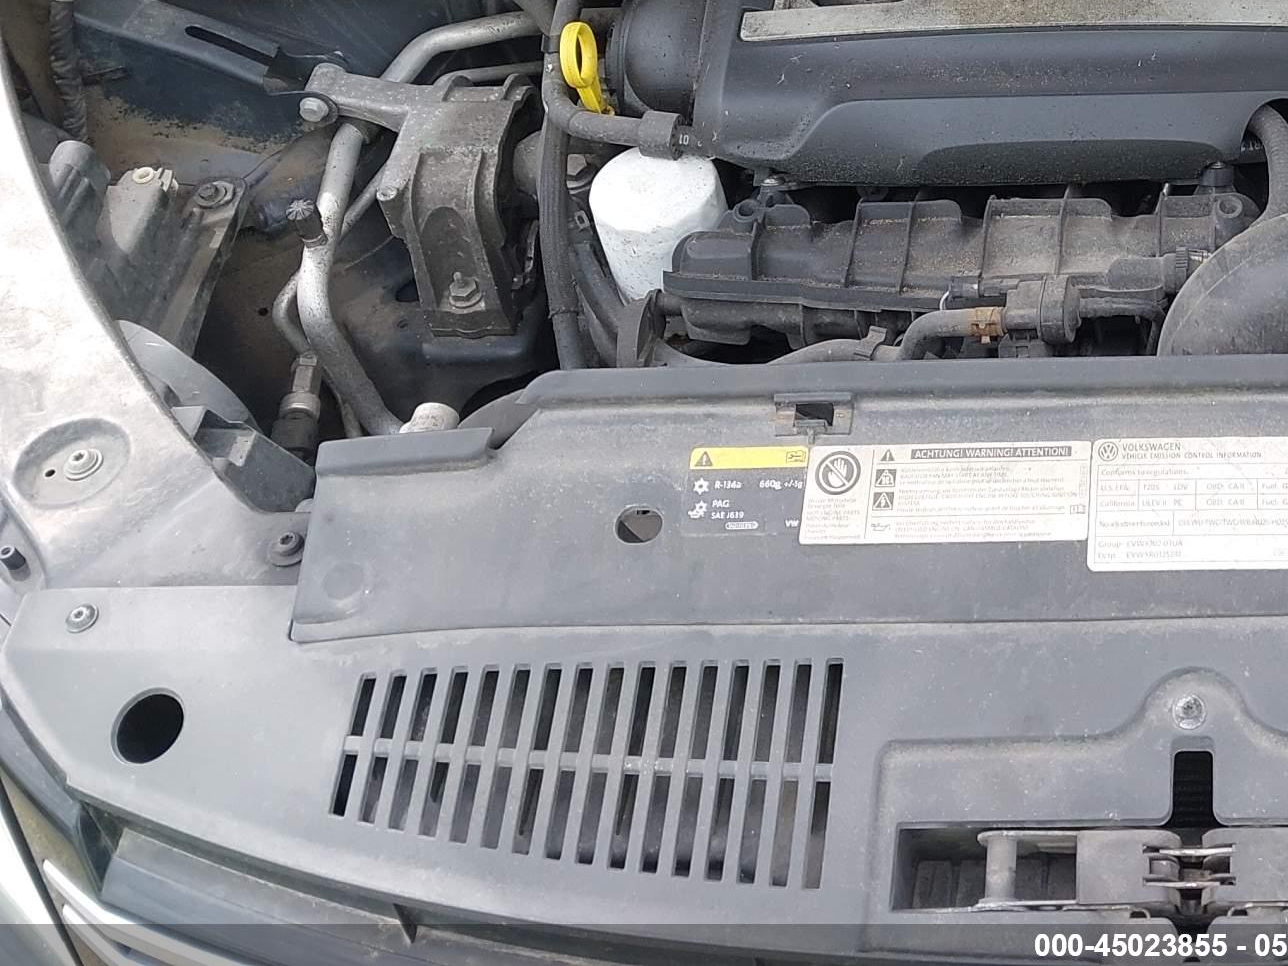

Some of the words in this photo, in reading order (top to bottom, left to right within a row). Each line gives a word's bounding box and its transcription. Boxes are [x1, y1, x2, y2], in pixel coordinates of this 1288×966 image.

[1122, 442, 1181, 452] VOLKSWAGEN
[914, 448, 963, 459] ACHTUNG!
[965, 447, 1014, 458] WARNING!
[1015, 446, 1069, 457] ATTENTION!
[1122, 452, 1147, 460] VEHICLE
[1217, 451, 1263, 459] INFORMATION
[715, 479, 742, 489] R-134a
[712, 499, 730, 508] PAG
[711, 511, 725, 519] SAE
[726, 511, 745, 519] J639
